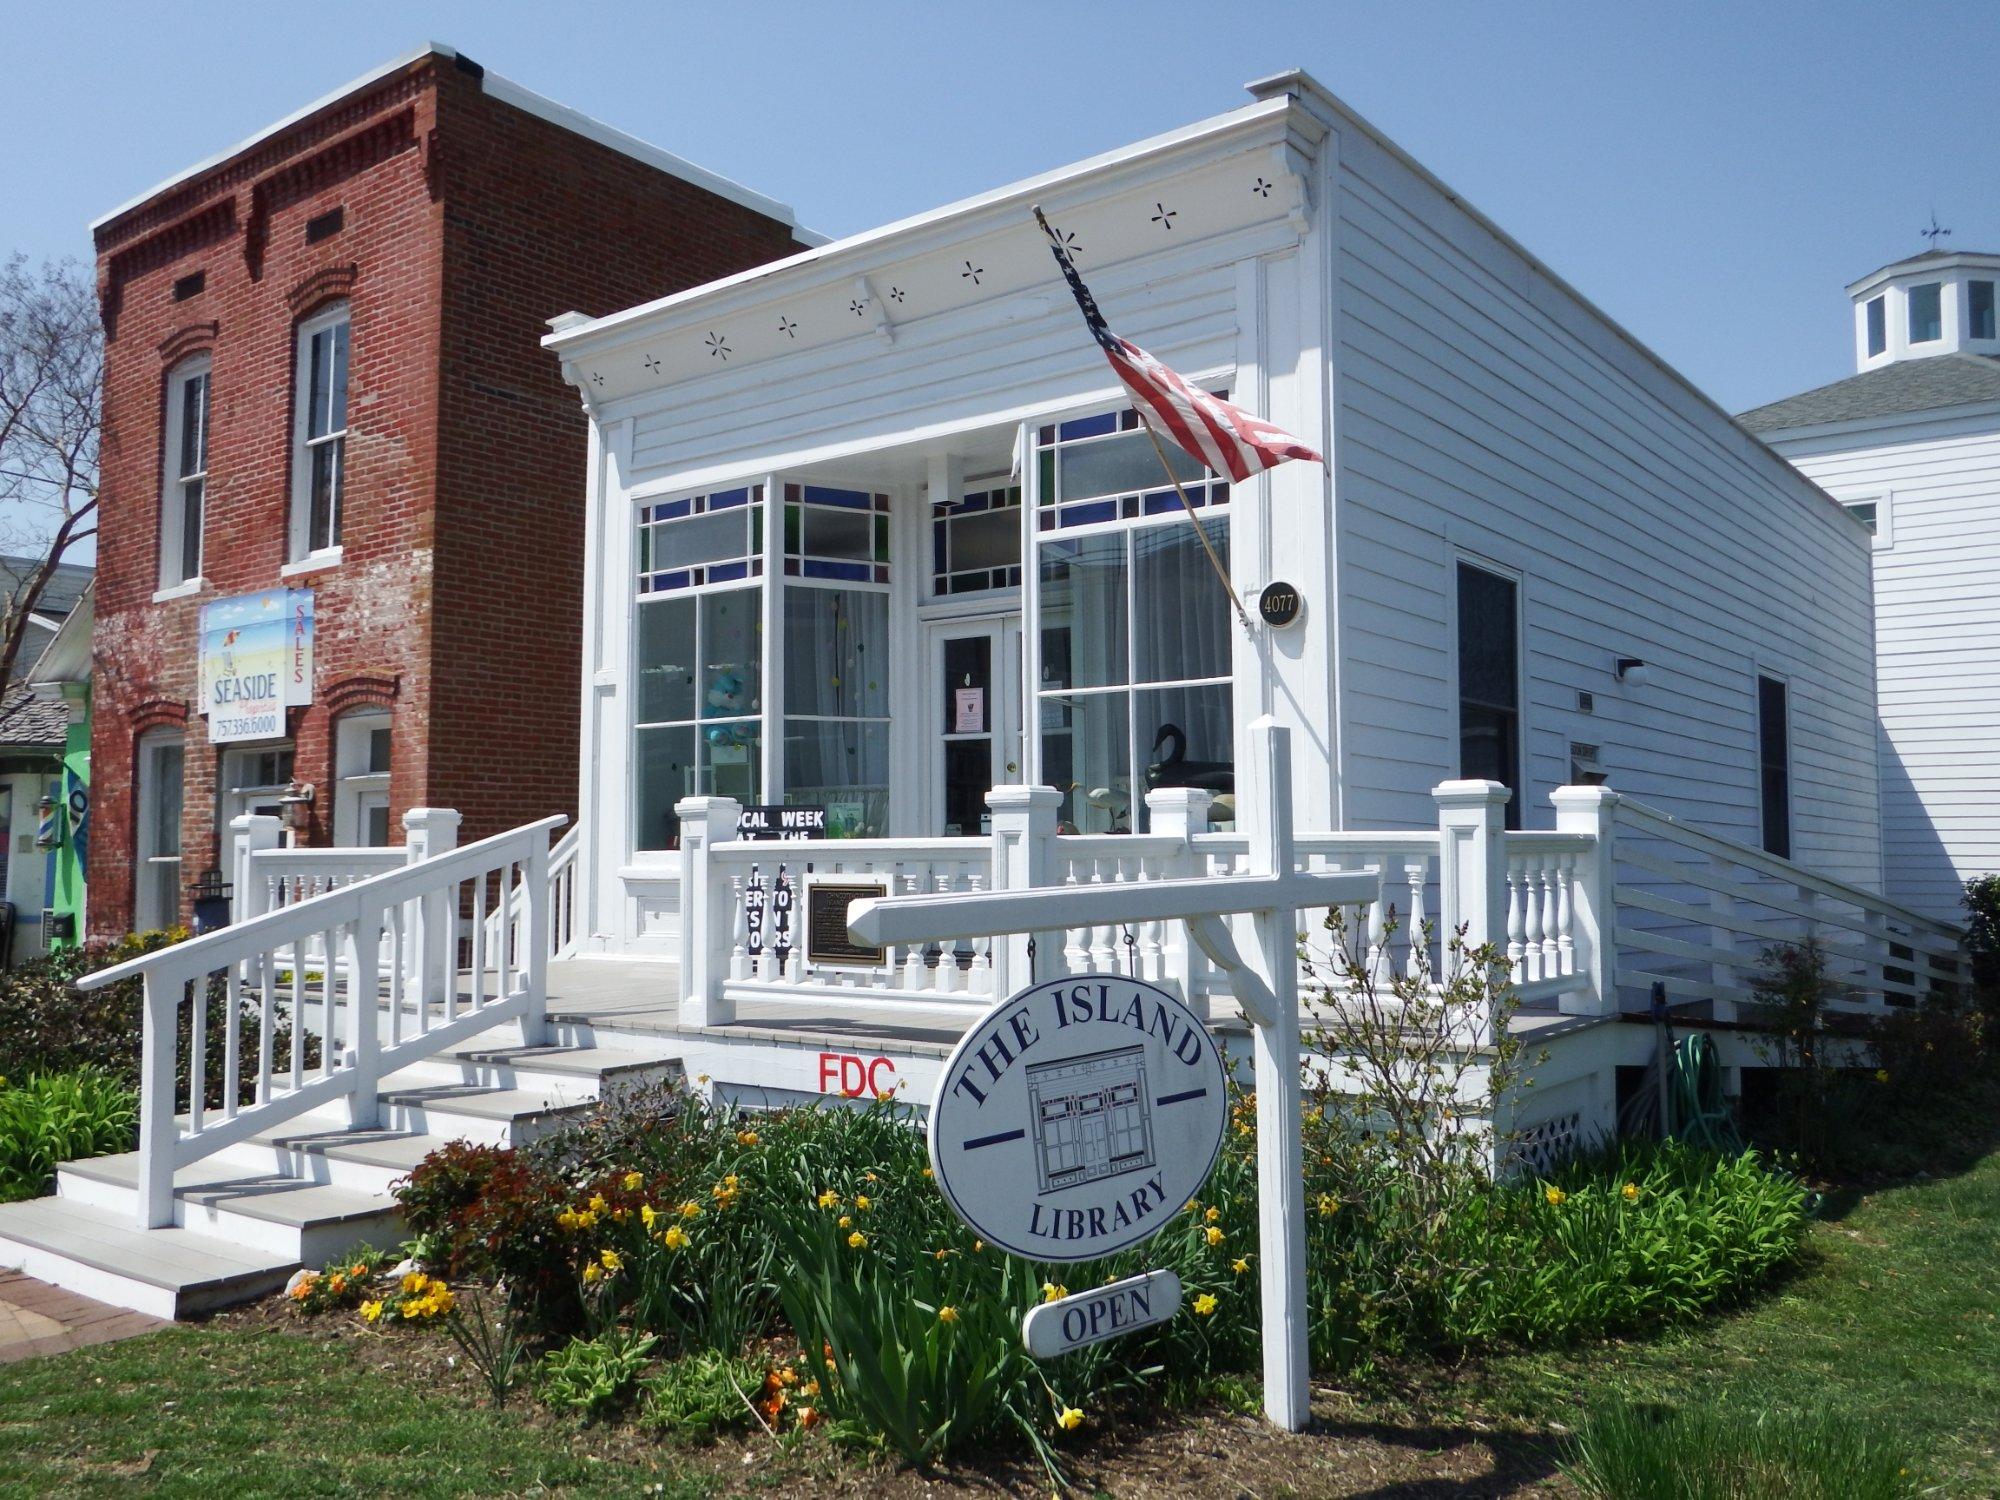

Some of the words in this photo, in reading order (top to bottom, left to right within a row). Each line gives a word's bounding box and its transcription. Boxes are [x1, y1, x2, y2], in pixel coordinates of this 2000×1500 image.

[1264, 594, 1294, 613] 4077
[294, 604, 306, 684] SALES
[215, 673, 277, 705] SEASIDE
[215, 715, 277, 737] 757.336.6000
[781, 811, 824, 828] WEEK
[952, 1006, 1041, 1110] THE
[1050, 983, 1203, 1067] ISLAND
[819, 1052, 896, 1099] FDC
[1027, 1170, 1169, 1241] LIBRARY
[1062, 1285, 1152, 1342] OPEN
